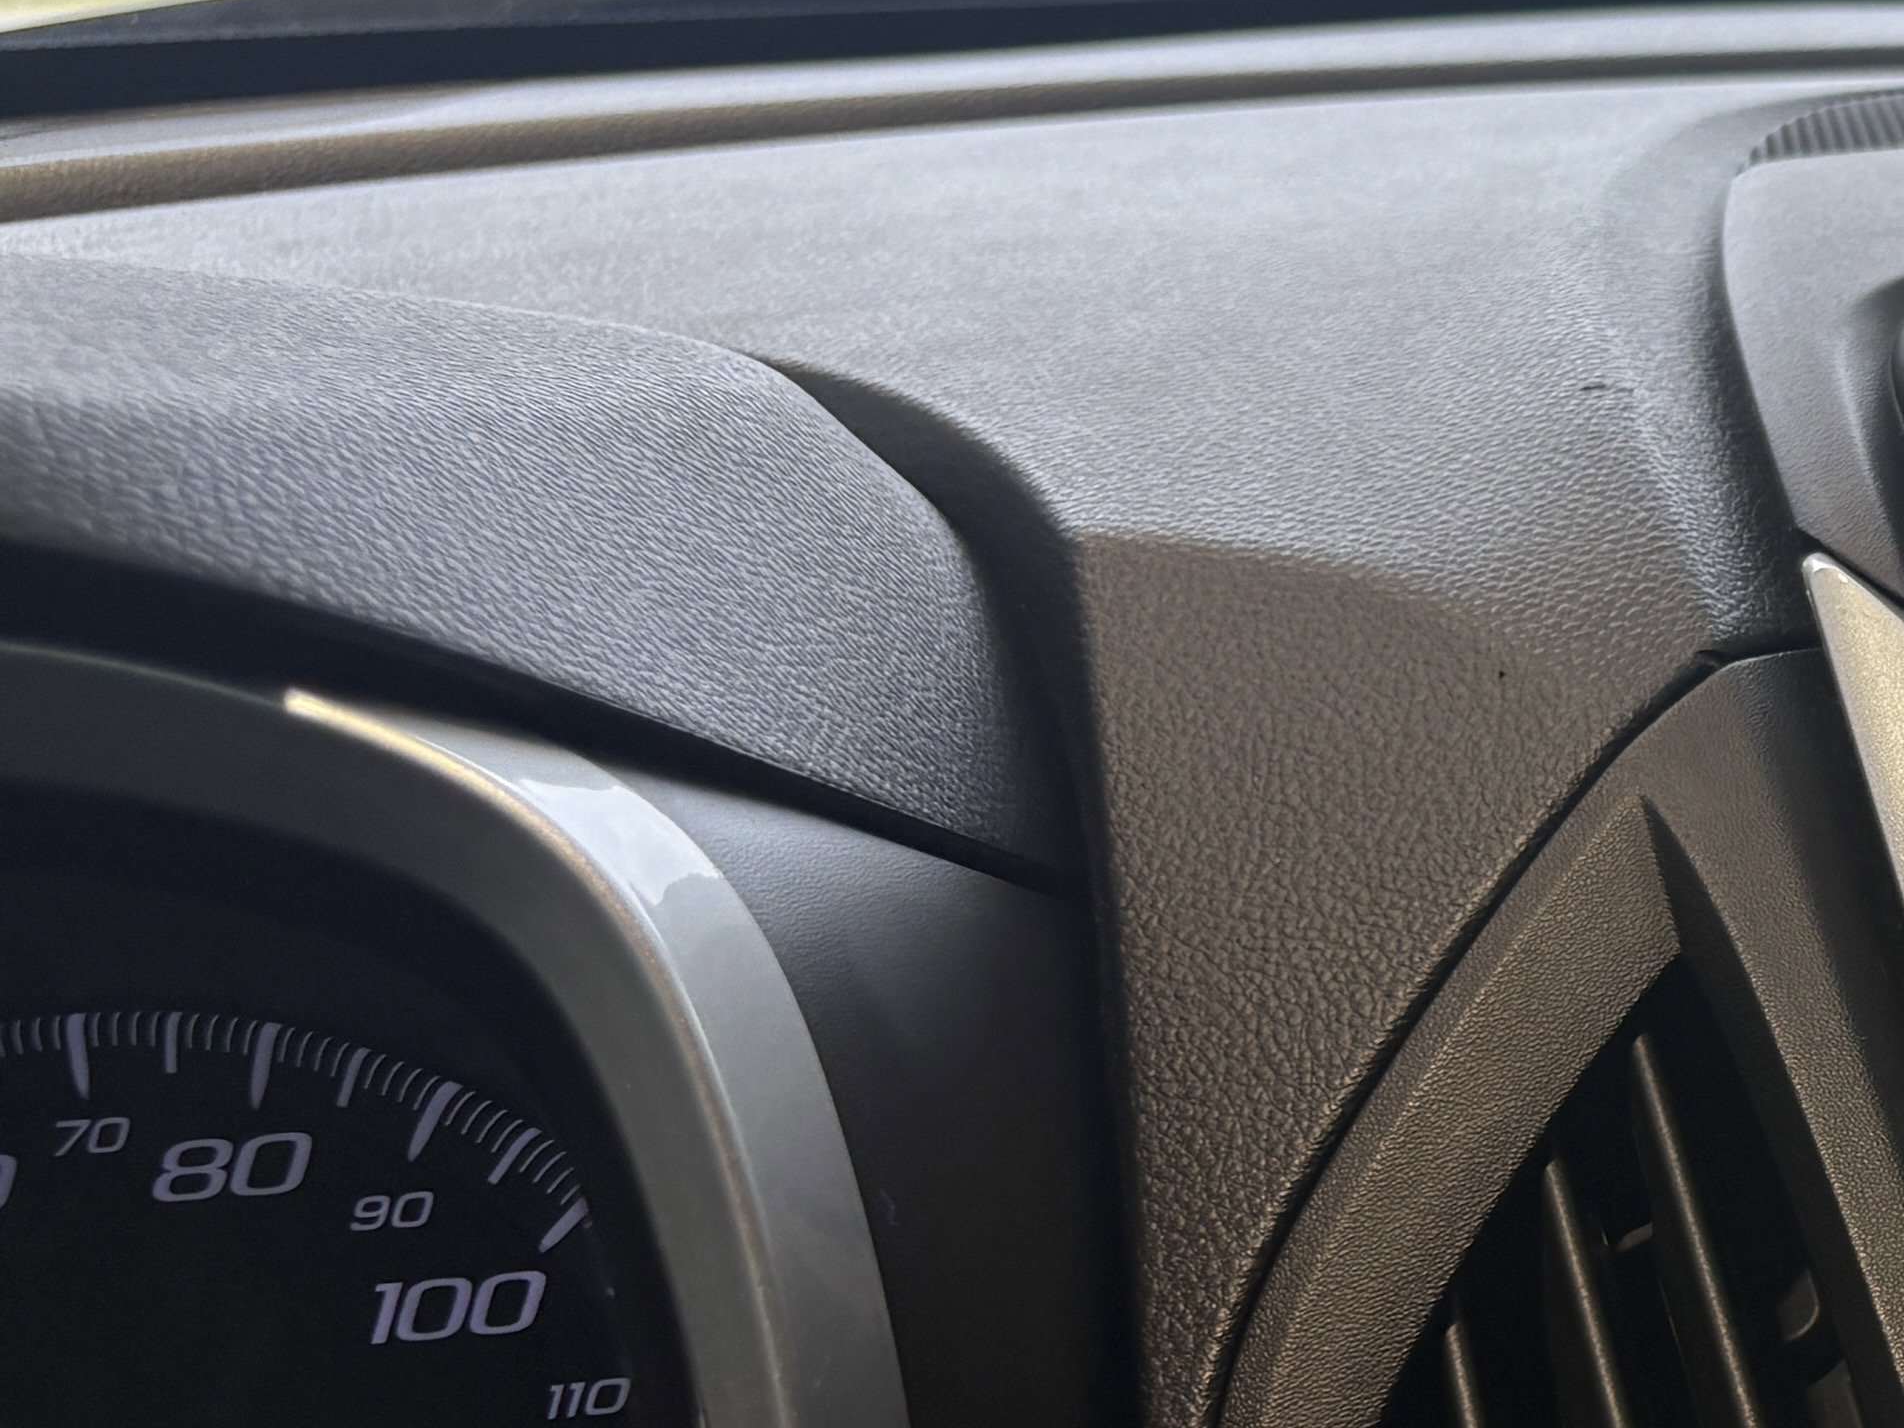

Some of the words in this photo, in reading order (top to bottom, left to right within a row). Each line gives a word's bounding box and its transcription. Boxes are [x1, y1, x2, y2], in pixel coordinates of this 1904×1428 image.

[54, 1117, 130, 1157] 70
[152, 1131, 311, 1202] 80
[349, 1190, 433, 1231] 90
[370, 1269, 547, 1344] 100
[547, 1377, 630, 1420] 110
